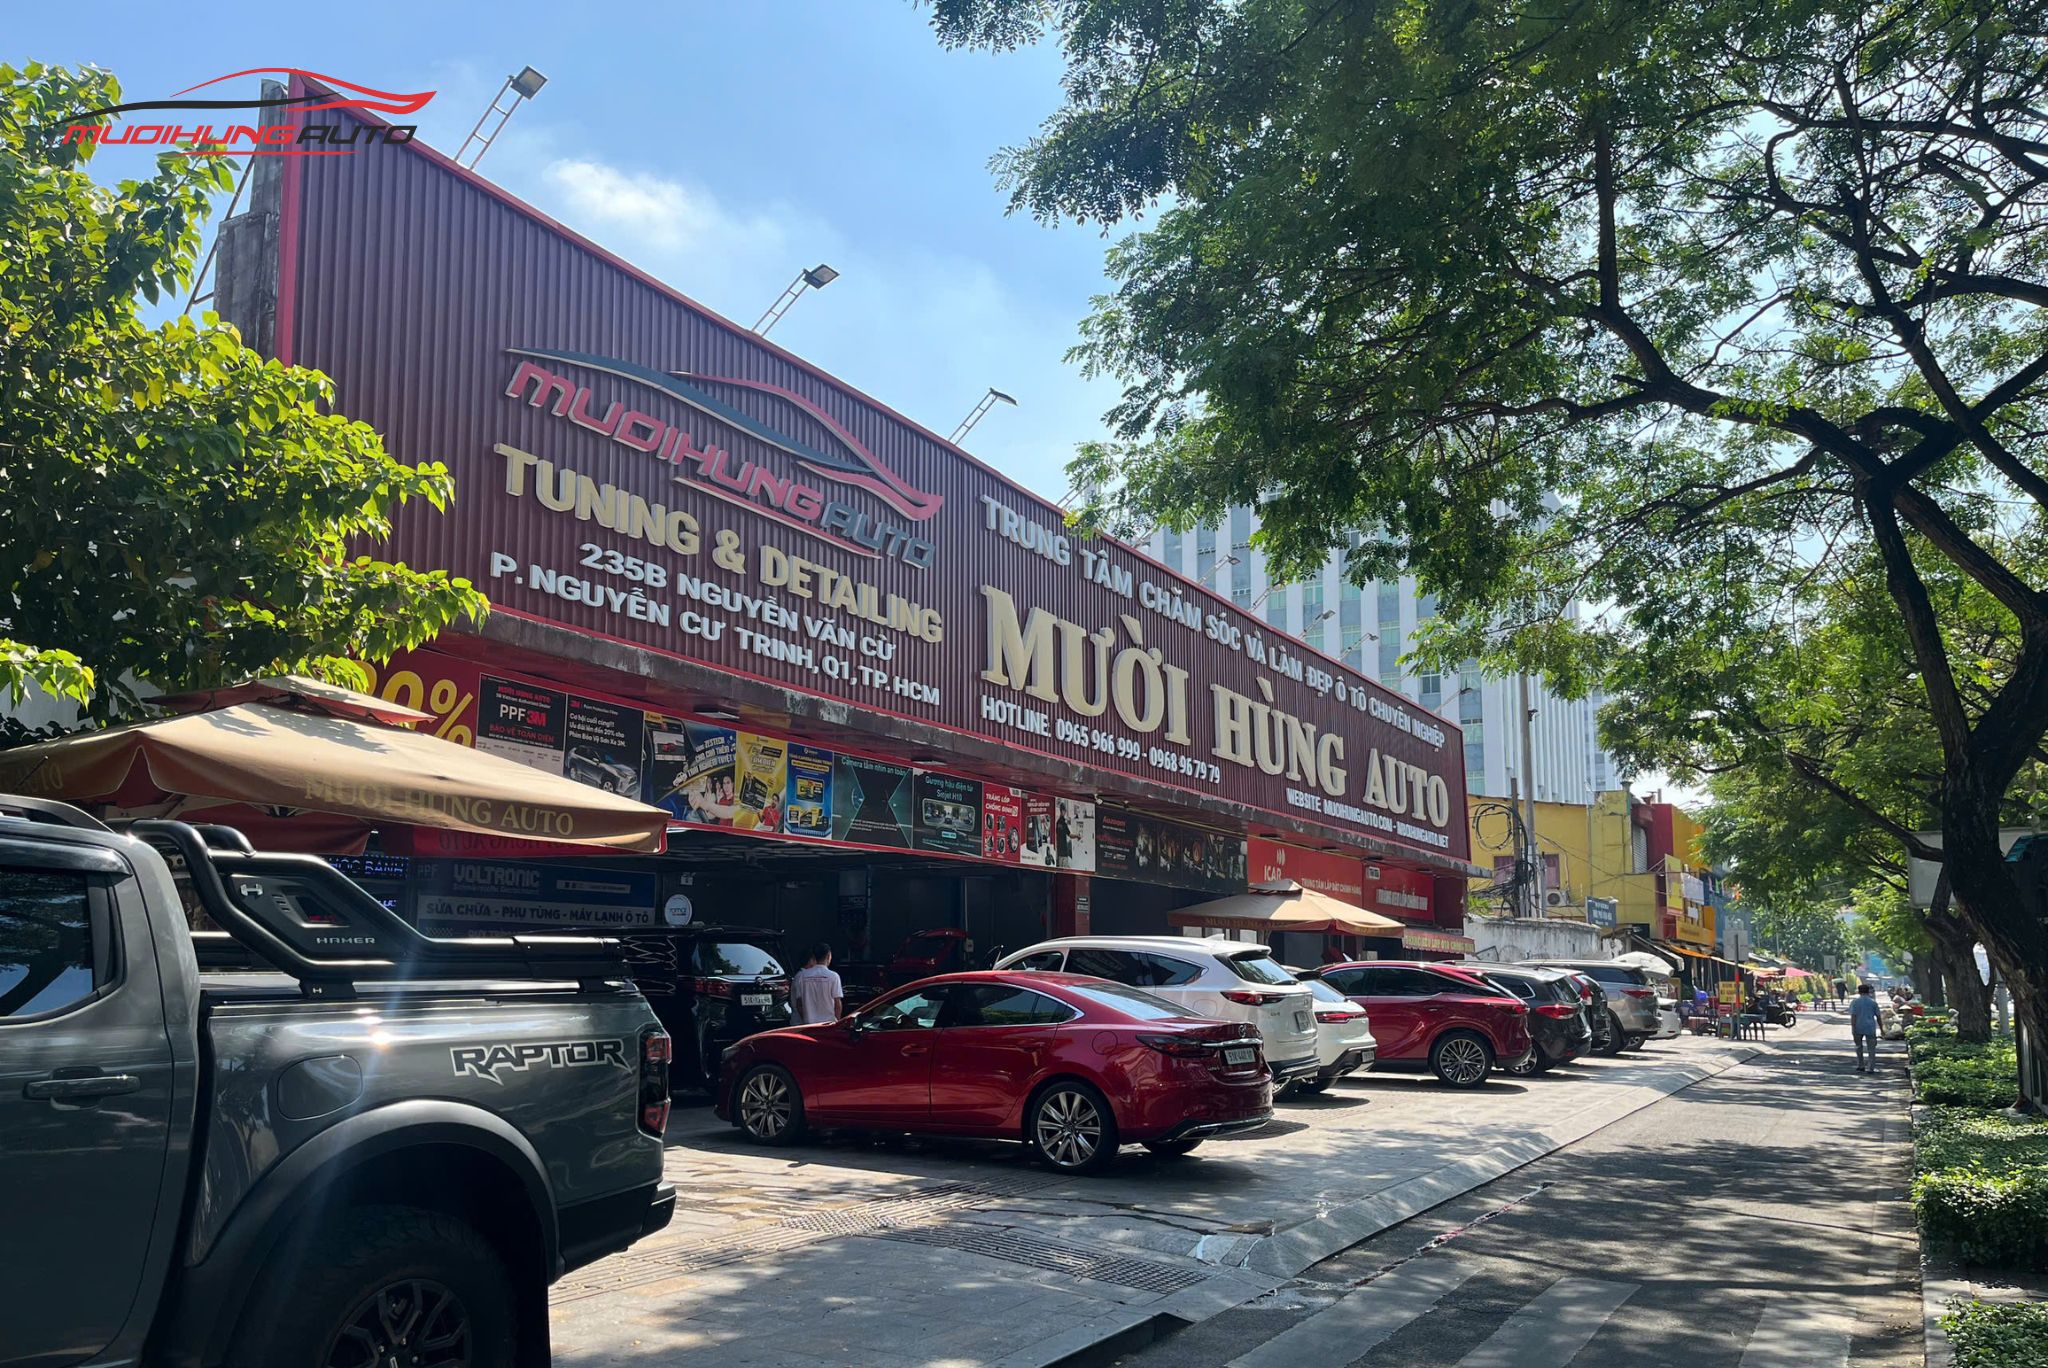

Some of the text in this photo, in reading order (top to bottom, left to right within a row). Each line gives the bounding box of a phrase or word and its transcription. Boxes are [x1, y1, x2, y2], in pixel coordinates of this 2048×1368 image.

[494, 442, 943, 643] TUNING & DETAILING
[529, 563, 670, 627] NGUYỄN
[679, 611, 726, 641] CƯ
[579, 543, 896, 661] 235B NGUYỄN VĂN CỪ
[980, 495, 1445, 752] TRUNG TÂM CHĂM SÓC VÀ LÀM ĐẸP Ô TÔ CHUYÊN NGHIỆP
[500, 704, 547, 726] PPF 3M
[981, 584, 1449, 828] MƯỜI HÙNG AUTO
[1055, 718, 1089, 747] 0965
[1091, 729, 1115, 755] 966
[1117, 737, 1140, 761] 999
[1149, 746, 1178, 772] 0968
[500, 804, 574, 836] AUTO
[450, 1039, 632, 1086] RAPTOR
